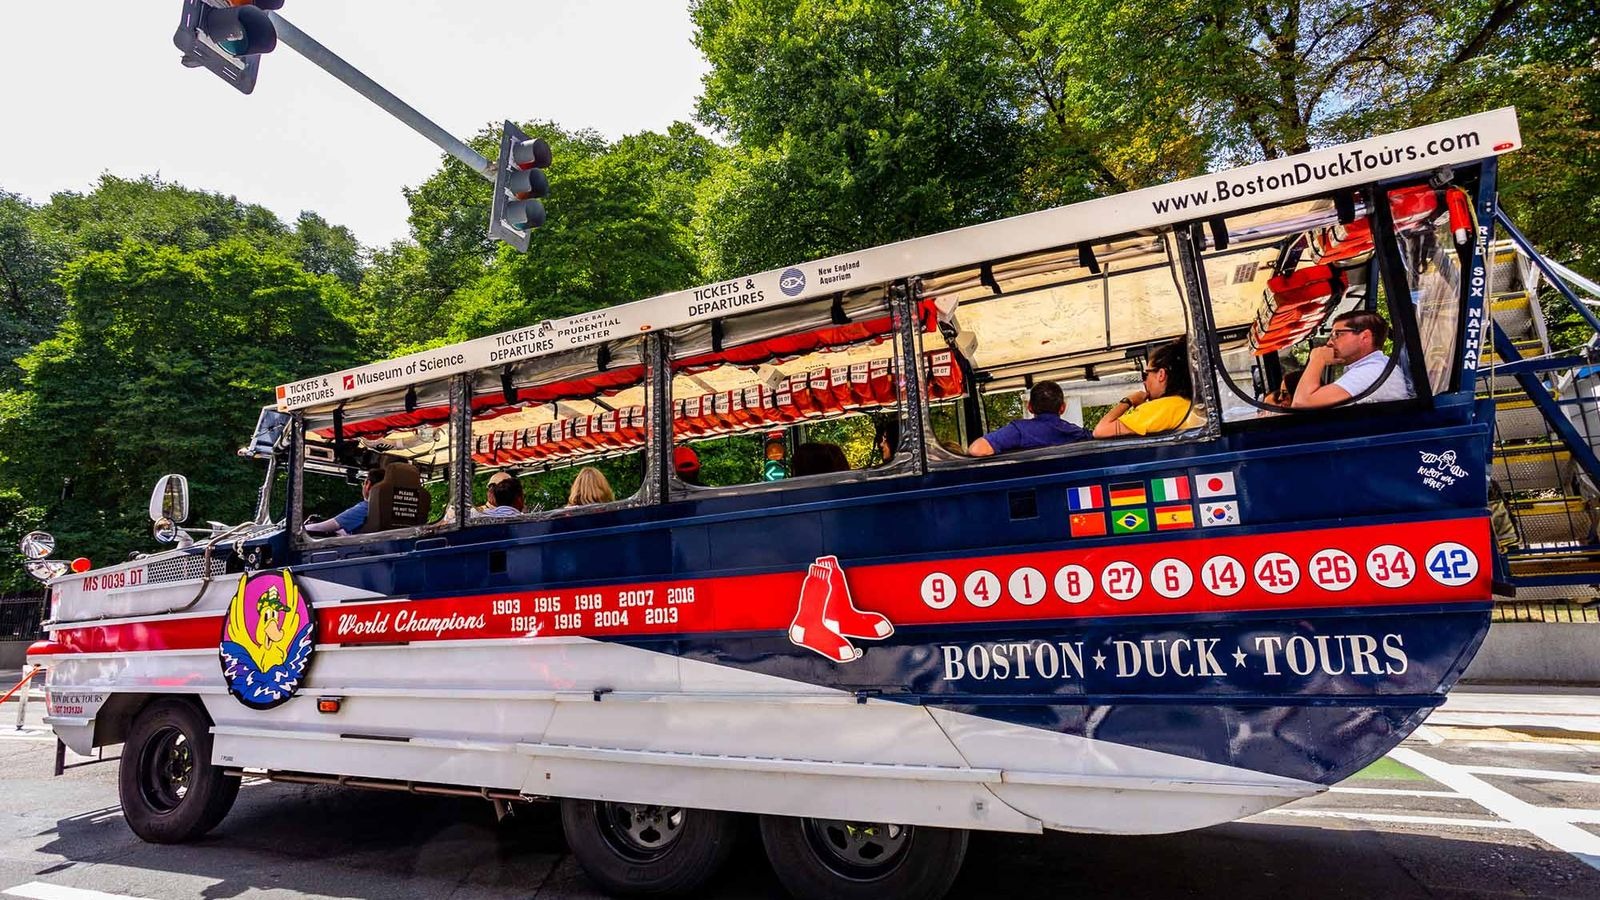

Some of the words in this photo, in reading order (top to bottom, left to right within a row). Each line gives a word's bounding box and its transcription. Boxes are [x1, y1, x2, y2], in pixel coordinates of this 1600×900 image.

[1152, 129, 1480, 214] www.BostonDuckTours.com
[1475, 226, 1487, 256] RED
[818, 267, 832, 276] New
[834, 260, 860, 275] England
[819, 272, 851, 285] Aquarium
[693, 281, 739, 301] TICKETS
[745, 278, 755, 290] &
[1470, 267, 1484, 297] SOX
[688, 290, 765, 317] DEPARTURES
[557, 317, 621, 337] PRUDENTIAL
[569, 316, 589, 325] BACK
[591, 312, 607, 322] BAY
[495, 330, 536, 347] TICKETS
[537, 328, 546, 338] &
[570, 329, 610, 344] CENTER
[1463, 308, 1482, 370] NATHAN
[490, 339, 554, 362] DEPARTURES
[356, 367, 403, 387] Museum
[405, 361, 418, 375] of
[419, 352, 465, 373] Science
[286, 388, 335, 407] DEPARTURES
[289, 380, 319, 394] TICKETS
[322, 378, 329, 387] &
[1423, 477, 1445, 491] HERE!
[1440, 475, 1456, 485] WAS
[1209, 562, 1238, 588] 14
[1259, 559, 1293, 586] 45
[1316, 557, 1349, 584] 26
[1373, 553, 1409, 580] 34
[1430, 549, 1471, 578] 42
[83, 576, 98, 591] MS
[102, 572, 125, 589] 0039
[130, 568, 143, 585] DT
[974, 577, 988, 600] 4
[1022, 575, 1030, 597] 1
[1067, 572, 1080, 596] 8
[1108, 569, 1136, 594] 27
[1165, 566, 1179, 590] 6
[492, 600, 520, 615] 1903
[534, 597, 561, 613] 1915
[575, 594, 602, 610] 1918
[619, 590, 654, 607] 2007
[668, 588, 695, 604] 2018
[931, 580, 944, 601] 9
[338, 612, 388, 635] World
[394, 610, 486, 637] Champions
[511, 616, 537, 632] 1912
[554, 613, 581, 629] 1916
[594, 611, 629, 627] 2004
[645, 608, 678, 624] 2013
[941, 642, 1084, 681] BOSTON
[1115, 637, 1227, 678] DUCK
[1255, 634, 1409, 676] TOURS
[62, 695, 80, 704] DUCK
[82, 694, 103, 703] TOURS
